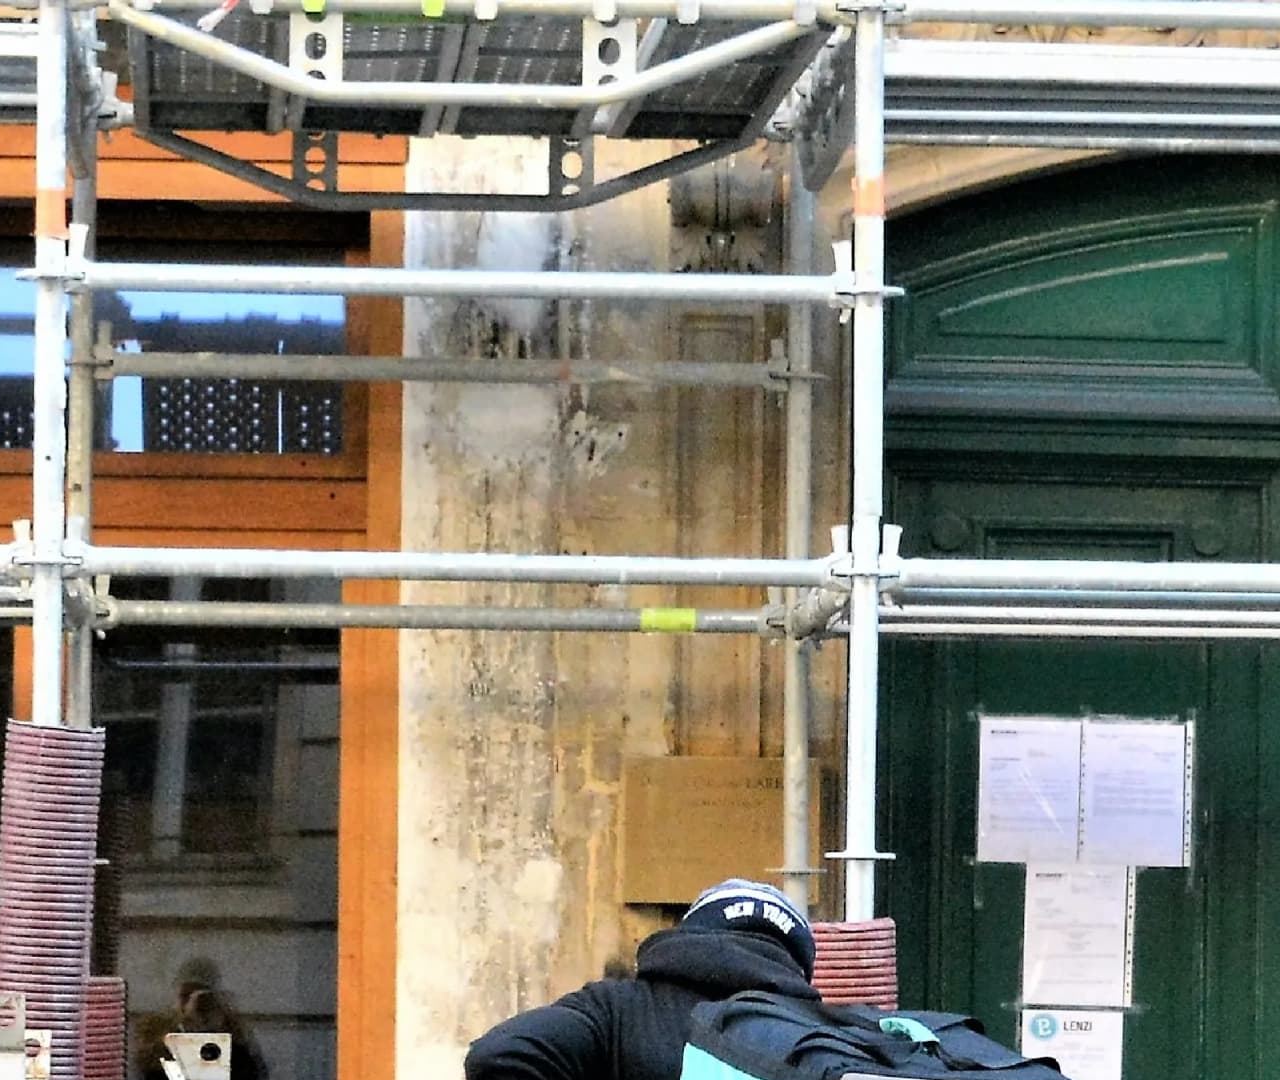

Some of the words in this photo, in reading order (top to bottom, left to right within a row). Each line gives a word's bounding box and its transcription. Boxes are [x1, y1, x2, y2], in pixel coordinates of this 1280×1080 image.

[723, 901, 755, 920] NEW
[763, 902, 795, 935] YORK
[1063, 1021, 1093, 1031] LENZI
